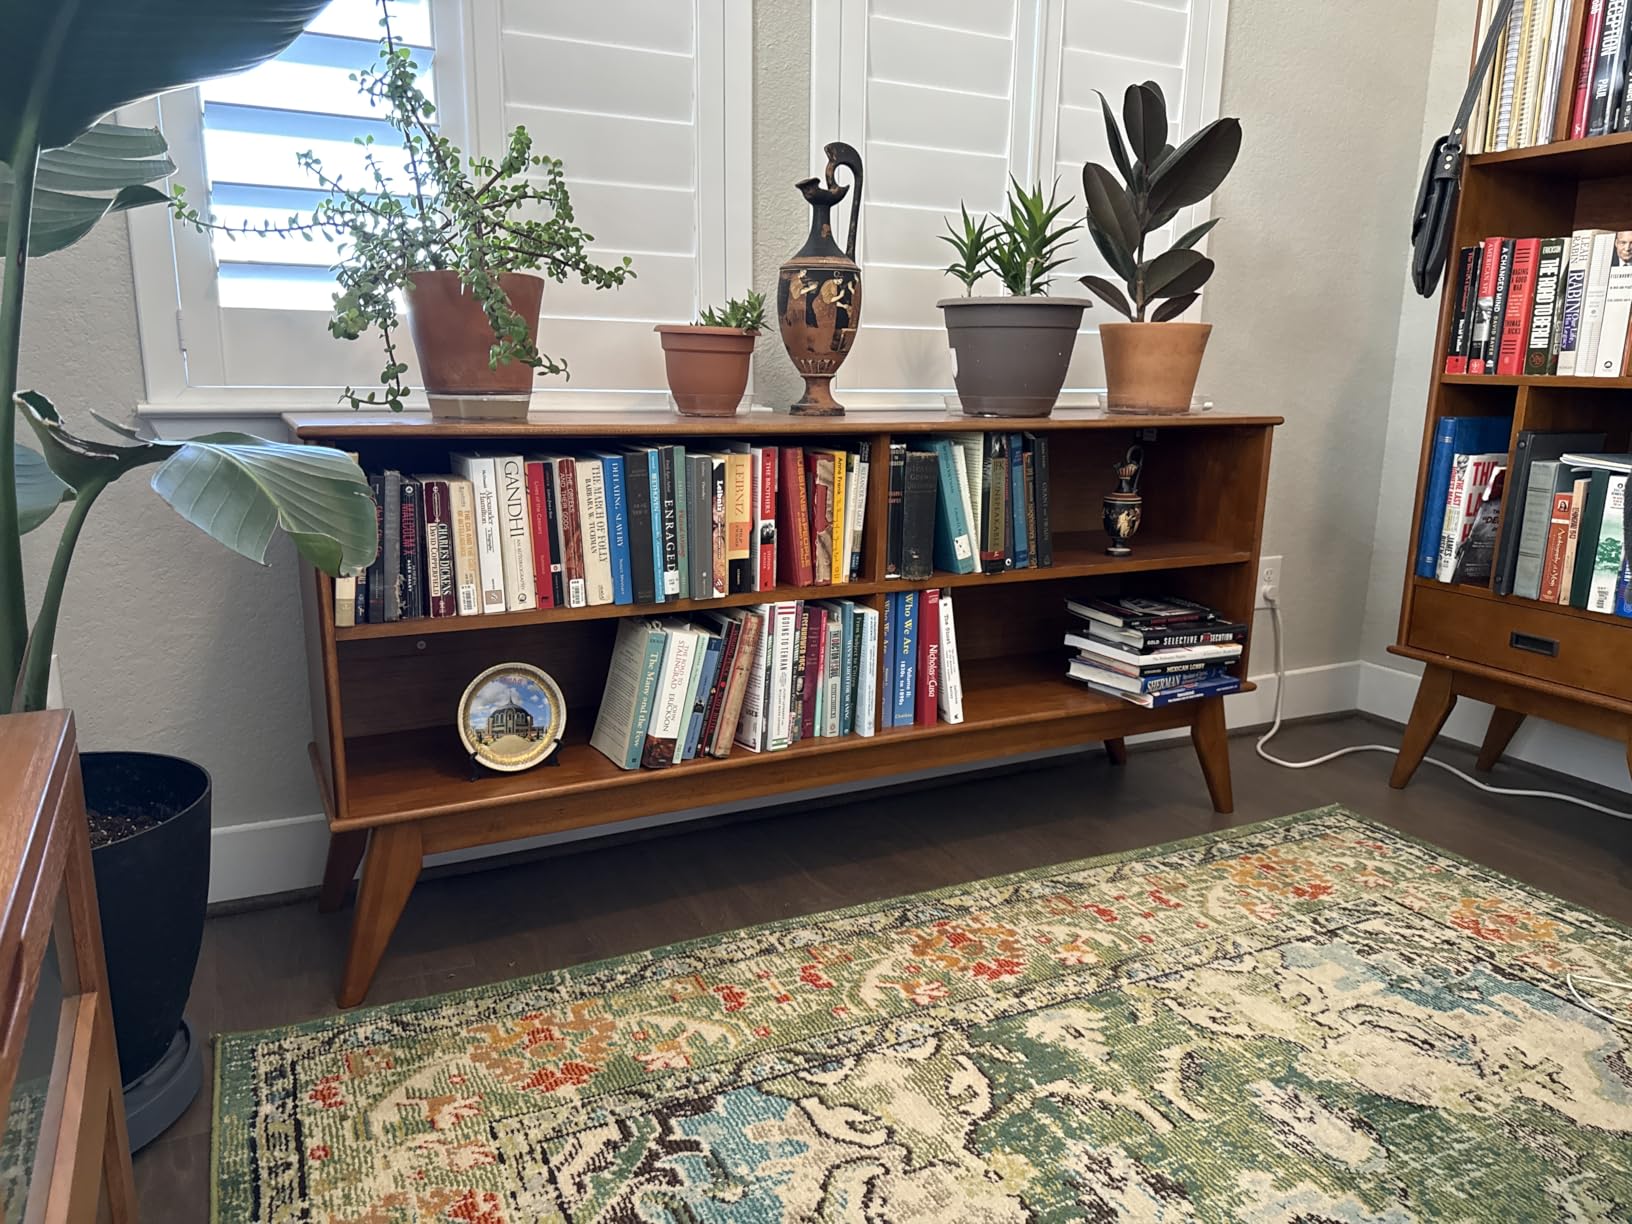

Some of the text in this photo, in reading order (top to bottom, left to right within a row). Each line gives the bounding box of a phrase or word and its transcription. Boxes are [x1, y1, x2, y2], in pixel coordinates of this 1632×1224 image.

[1595, 79, 1609, 100] PAUL
[1570, 235, 1581, 264] RABIN
[1580, 236, 1591, 261] LEAH
[1481, 243, 1494, 295] AMERICAN SPY
[1496, 254, 1508, 291] CHANGED
[1493, 292, 1503, 312] MIND
[1529, 258, 1560, 348] THE ROAD TO BERLIN
[1565, 271, 1585, 313] RABIN
[1571, 313, 1580, 328] Our
[1488, 336, 1496, 356] BAYER
[1561, 326, 1570, 349] Legacy
[584, 478, 595, 511] BARBARA
[716, 480, 724, 513] Leibniz
[735, 464, 744, 516] LEIBNIZ
[796, 450, 808, 512] RUSSIANS
[857, 466, 867, 497] ALEXANDER
[1453, 479, 1465, 506] THE LAST
[479, 492, 487, 524] Hamilton
[485, 490, 495, 526] Alexander
[504, 461, 525, 538] GANDHI
[567, 488, 575, 513] GREEKS
[591, 465, 608, 563] THE MARCH OF FOLLY
[611, 462, 624, 547] DEFEATING SLAVERY
[992, 482, 1002, 547] UNSPEAKABLE
[401, 503, 417, 548] MALCOLM
[562, 511, 570, 530] GODS
[855, 509, 864, 528] GREAT
[589, 522, 598, 554] TUCHMAN
[664, 500, 676, 572] ENRAGED
[801, 522, 811, 568] PEOPLE
[1444, 535, 1454, 557] JAMES
[1552, 527, 1566, 564] Autobiography
[429, 525, 440, 595] DAVID COPPERFIELD
[437, 523, 451, 596] CHARLES DICKENS
[516, 539, 525, 590] AN AUTOBIOGRAPHY
[799, 613, 809, 654] EISENHOWER
[902, 593, 914, 655] Who We Are
[1163, 635, 1198, 646] SELECTIVE
[779, 616, 791, 671] GOING TO TEHRAN
[830, 631, 840, 660] THE DOCTOR
[853, 634, 861, 657] Subject
[928, 644, 938, 676] Nicholas
[670, 639, 685, 689] STALINGRAD
[677, 645, 690, 686] THE ROAD TO
[797, 655, 806, 672] 1956
[830, 665, 840, 679] SOUL
[928, 680, 937, 698] Cusa
[1147, 674, 1182, 690] SHERMAN
[633, 651, 659, 747] The Many and the Few
[662, 693, 676, 732] ERICKSON
[671, 704, 679, 721] JOHN
